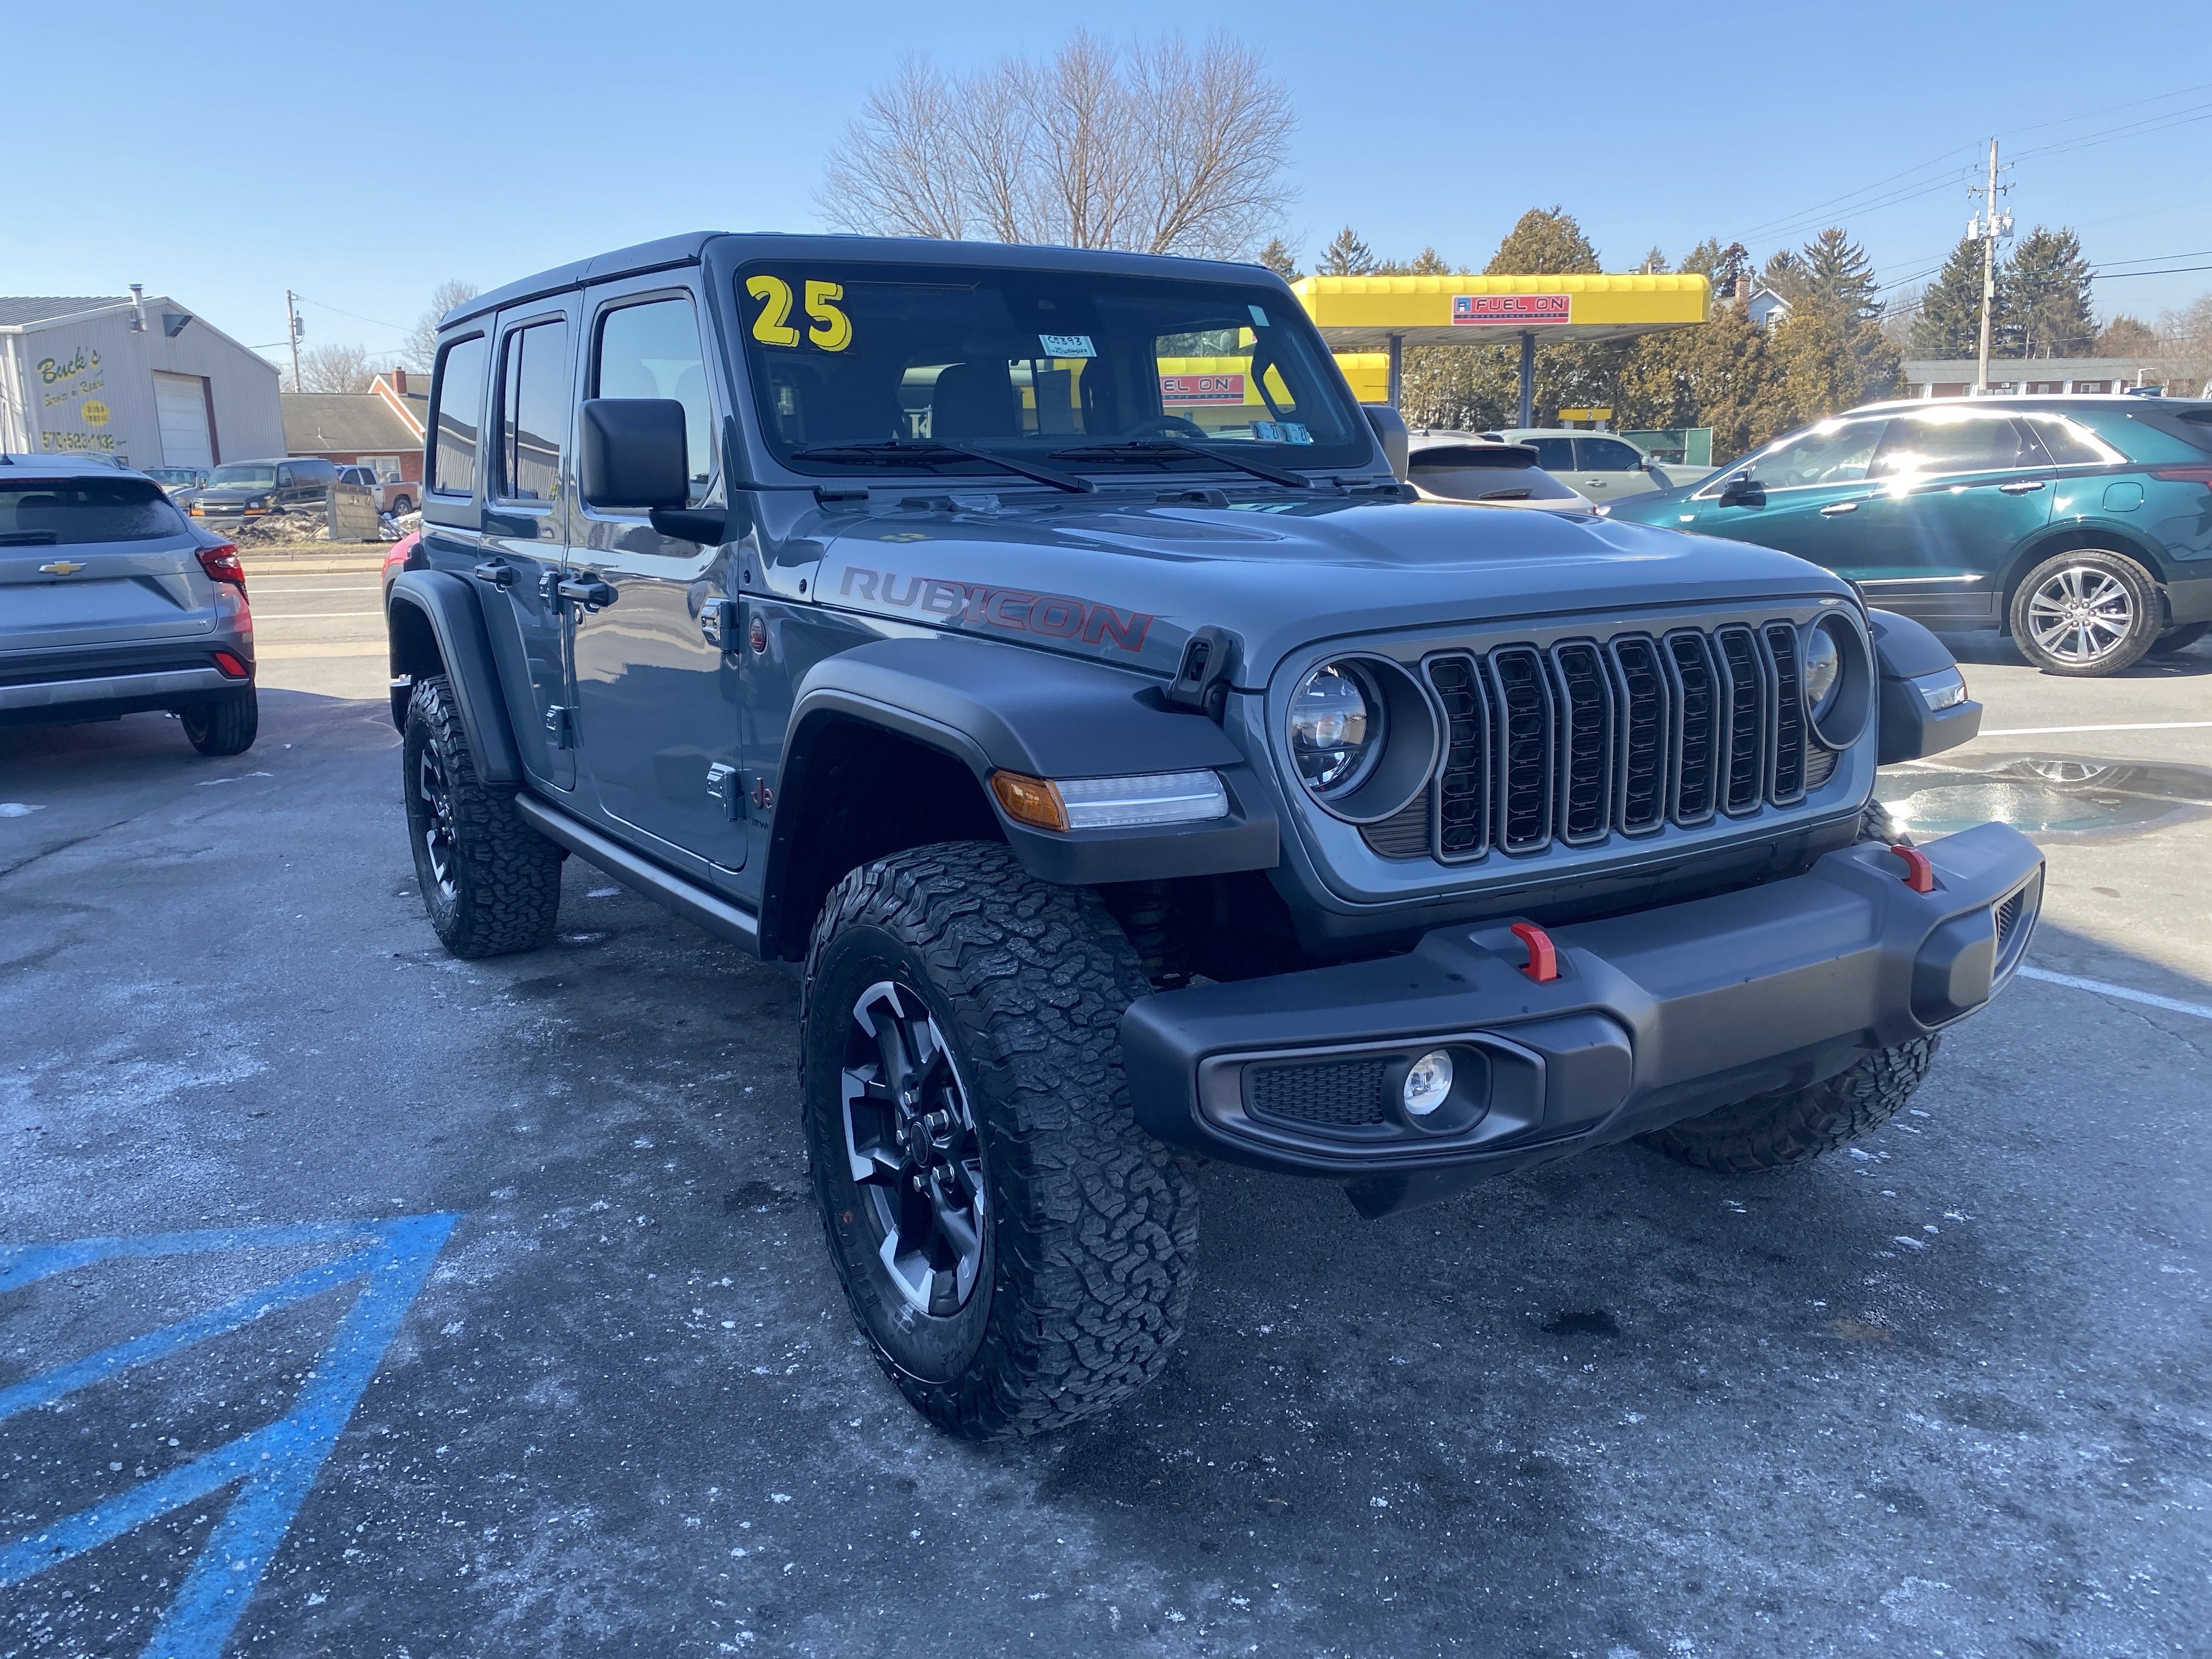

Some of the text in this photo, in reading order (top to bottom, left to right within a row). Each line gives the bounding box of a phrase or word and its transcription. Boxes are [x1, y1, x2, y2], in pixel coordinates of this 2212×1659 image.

[1476, 297, 1564, 311] FUEL ON
[746, 274, 852, 352] 25
[1048, 336, 1082, 346] C5393
[37, 346, 101, 384] Buck's
[1198, 377, 1230, 392] ON
[1588, 411, 1592, 420] 2
[837, 566, 1154, 652] RUBICON
